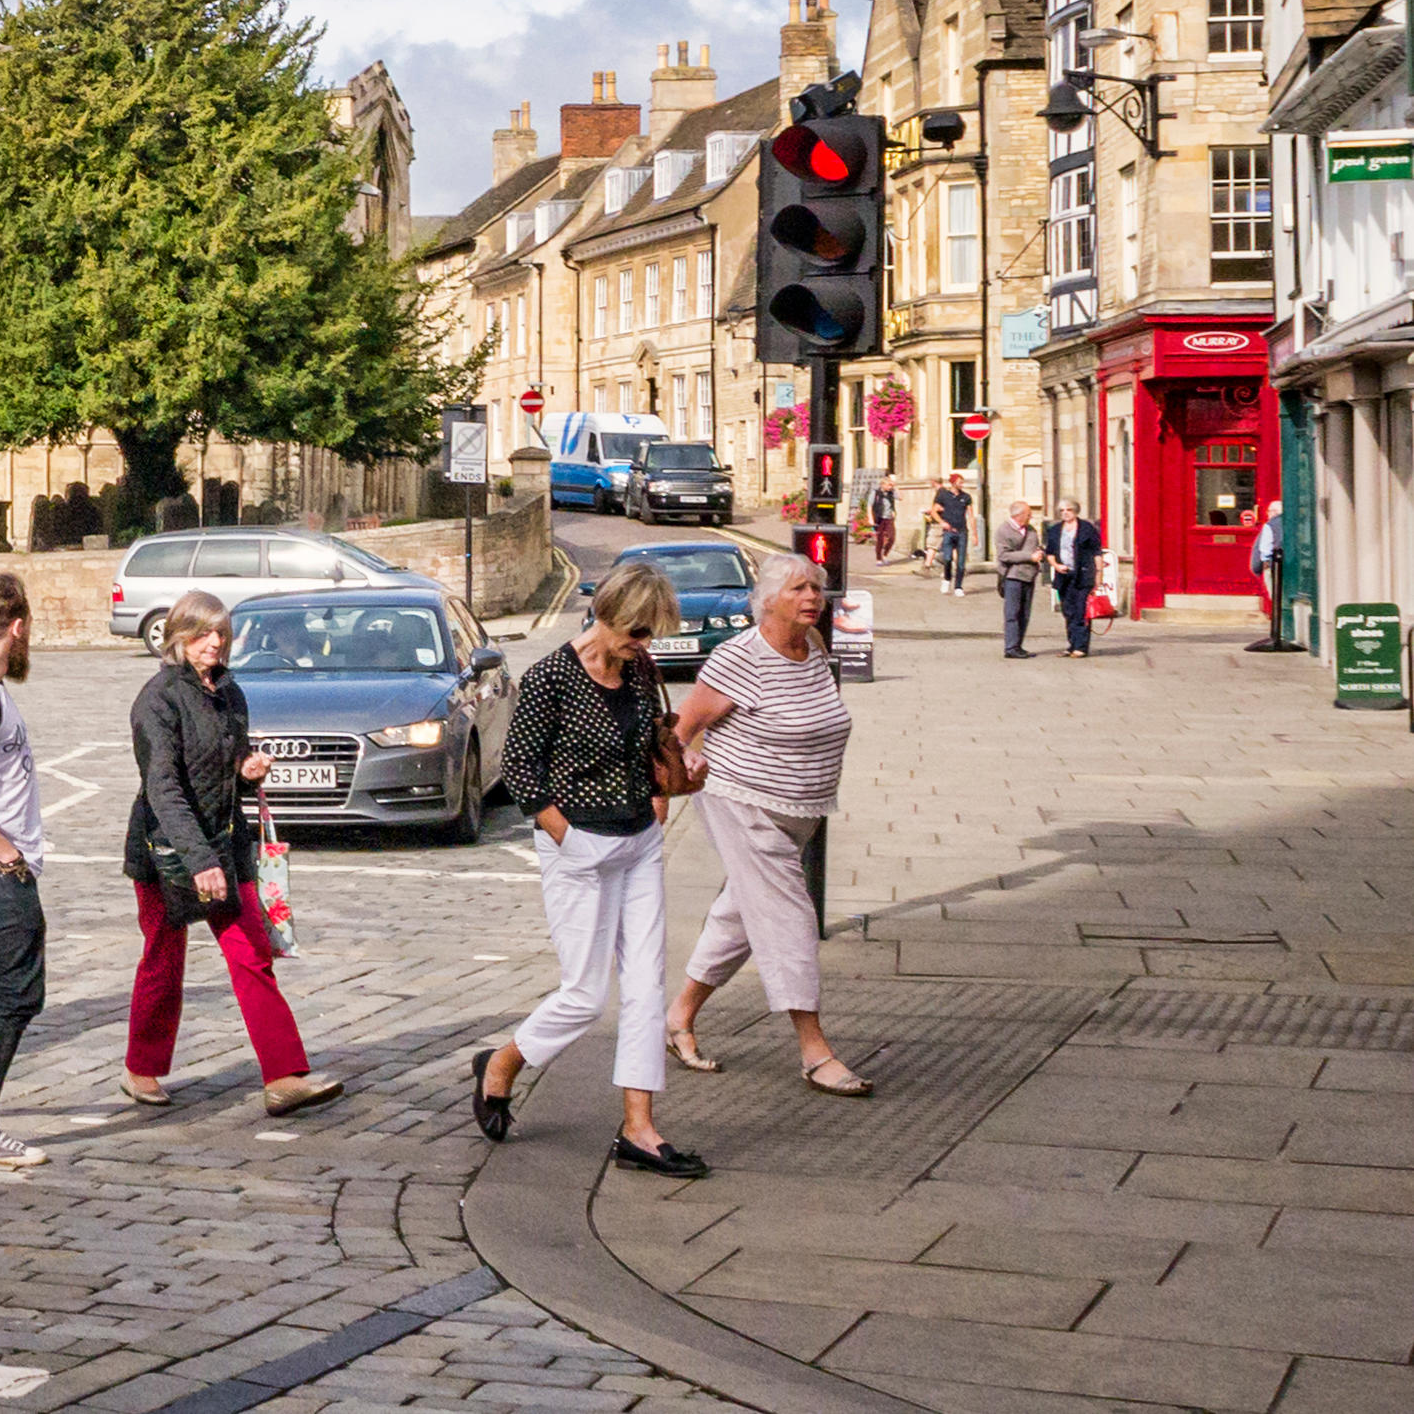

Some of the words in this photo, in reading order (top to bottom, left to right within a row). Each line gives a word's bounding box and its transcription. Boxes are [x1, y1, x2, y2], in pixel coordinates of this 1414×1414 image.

[1332, 156, 1365, 174] paul
[1368, 156, 1410, 172] green
[1192, 337, 1239, 346] MURRAY
[454, 472, 482, 481] ENDS
[673, 641, 694, 650] CCE
[270, 769, 292, 783] 63
[297, 769, 331, 783] PXM
